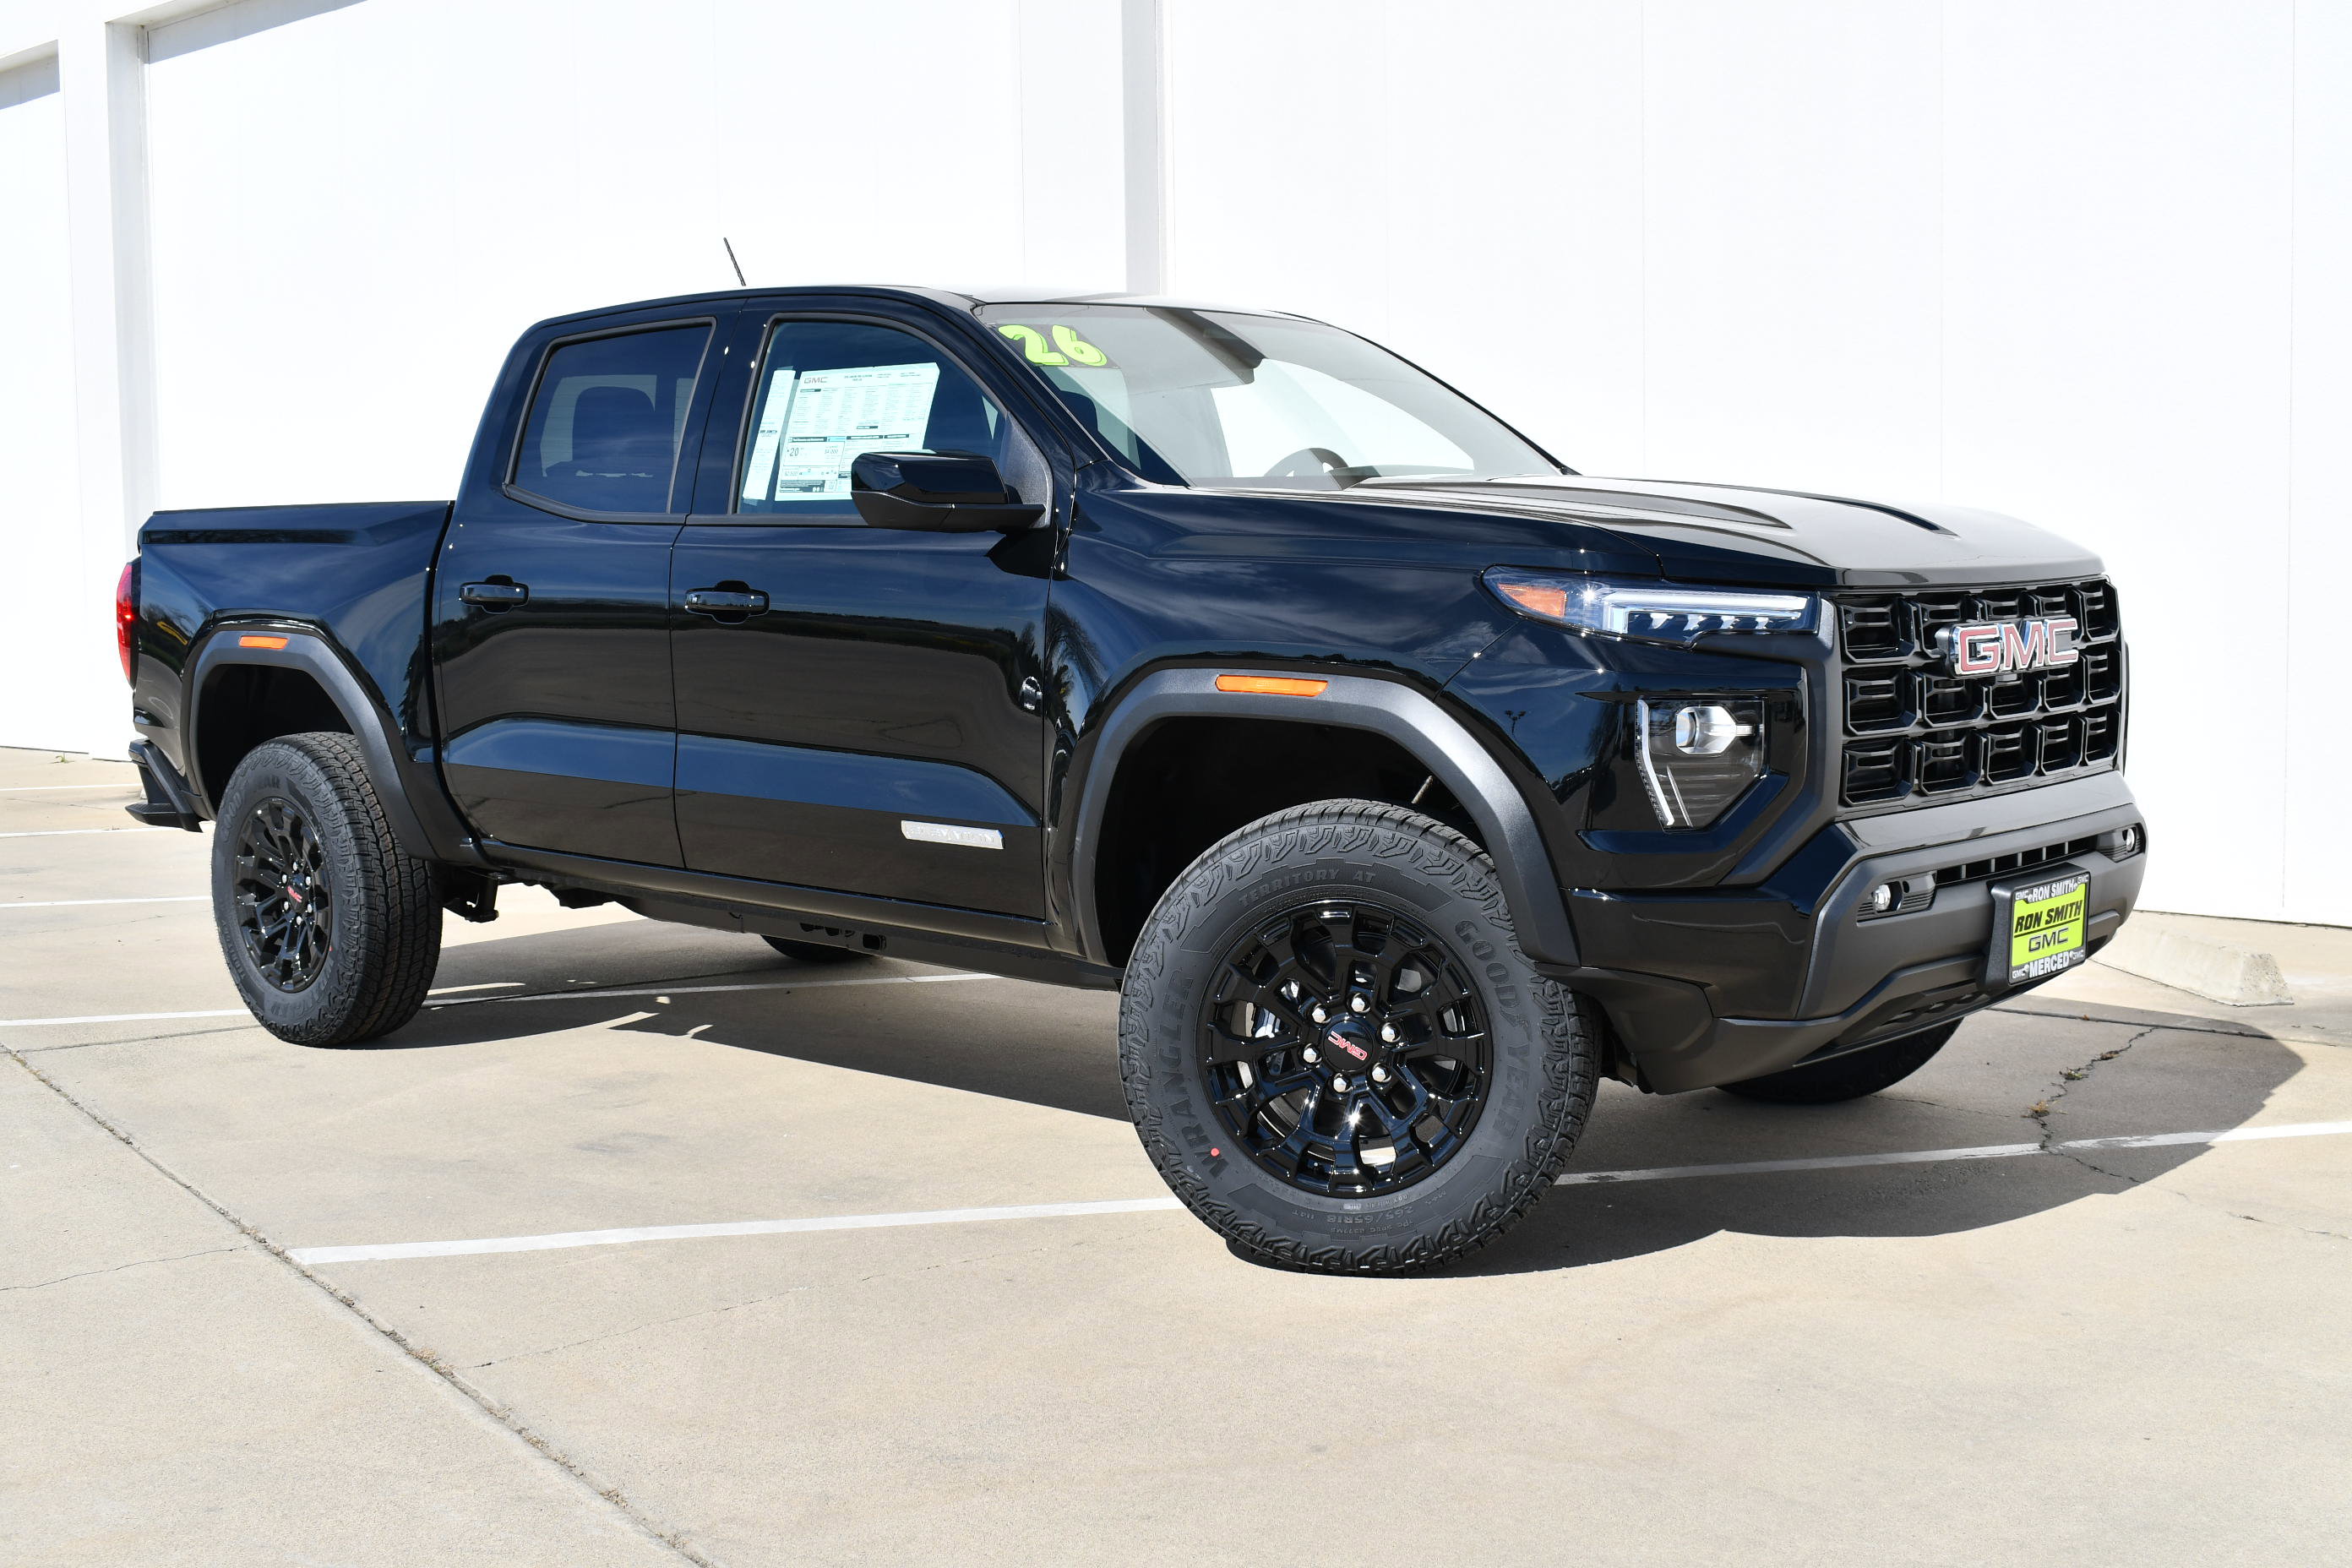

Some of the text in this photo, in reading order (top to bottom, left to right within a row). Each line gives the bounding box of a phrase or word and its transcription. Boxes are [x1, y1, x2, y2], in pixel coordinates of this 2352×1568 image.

[998, 324, 1108, 367] 26
[789, 447, 799, 457] 20
[1958, 618, 2079, 675] GMC
[1239, 868, 1341, 907] TERRITORY
[1353, 871, 1376, 884] AT
[2015, 890, 2028, 901] GMC
[2032, 885, 2050, 902] RON
[2050, 879, 2075, 897] SMITH
[2014, 900, 2082, 933] RON SMITH
[2028, 927, 2069, 952] GMC
[2012, 969, 2026, 979] GMC
[2028, 951, 2070, 978] MERCED
[1327, 1030, 1368, 1061] GMC
[1455, 919, 1533, 1139] GOODYEAR
[1157, 970, 1229, 1179] WRANGLER
